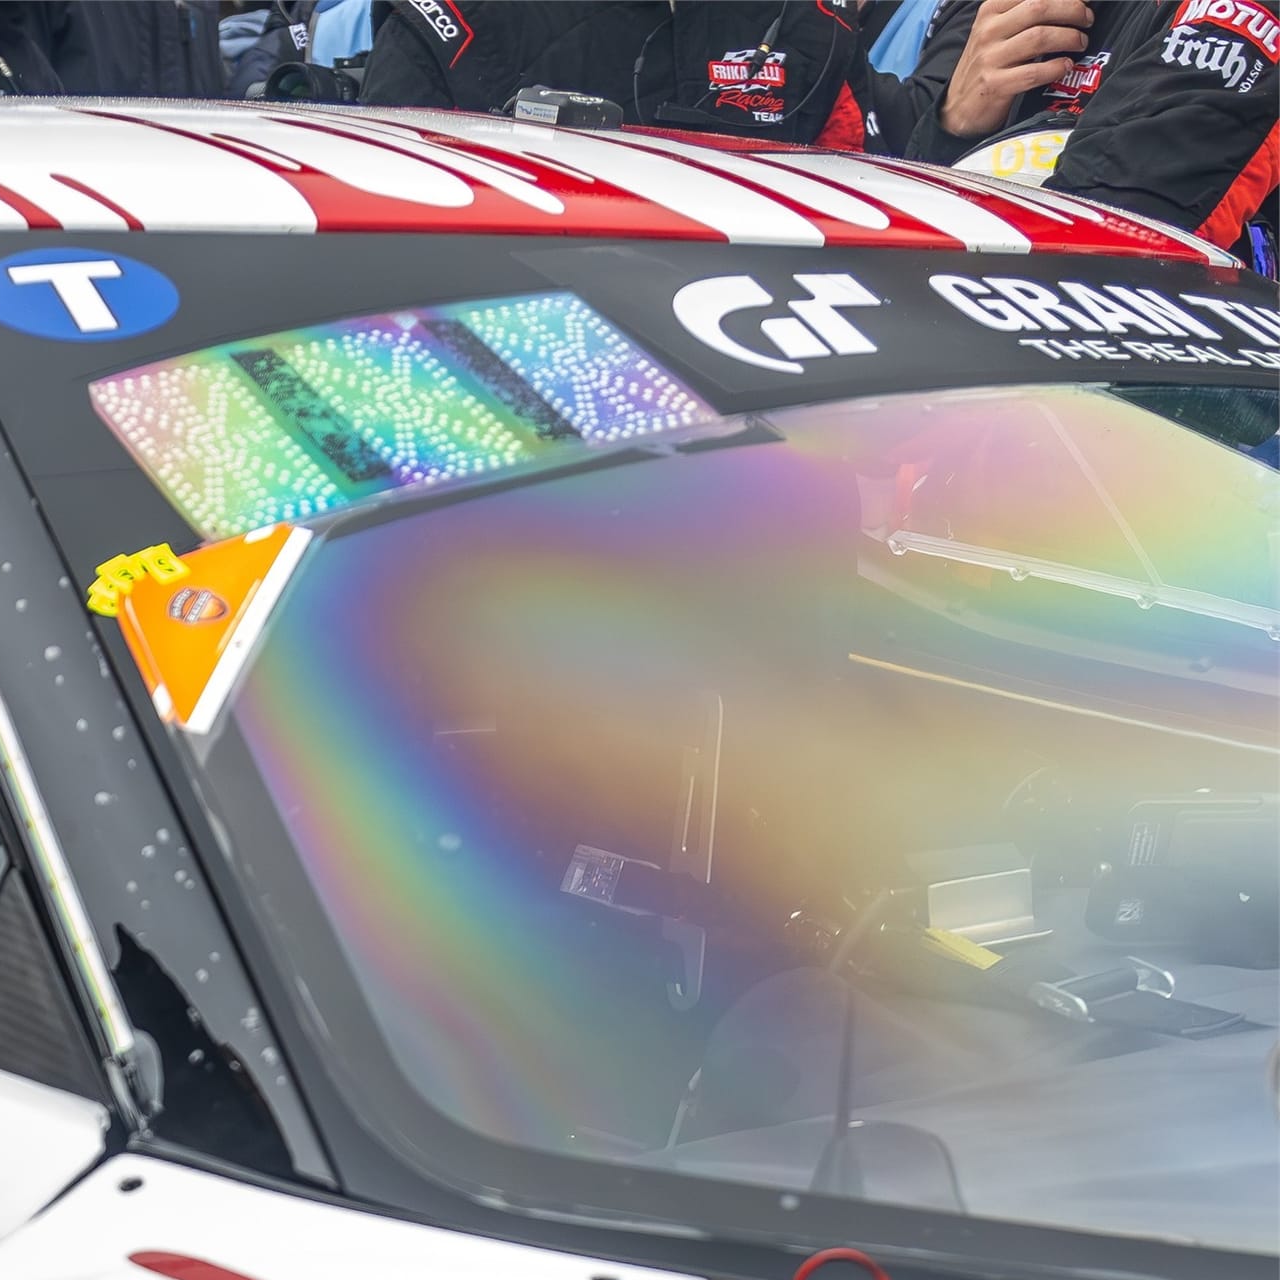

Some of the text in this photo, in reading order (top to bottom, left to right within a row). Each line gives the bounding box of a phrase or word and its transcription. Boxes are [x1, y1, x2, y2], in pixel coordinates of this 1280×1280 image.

[1178, 0, 1280, 53] MOTUL
[927, 273, 1224, 340] GRAN
[1019, 338, 1131, 361] THE
[1121, 341, 1251, 366] REAL
